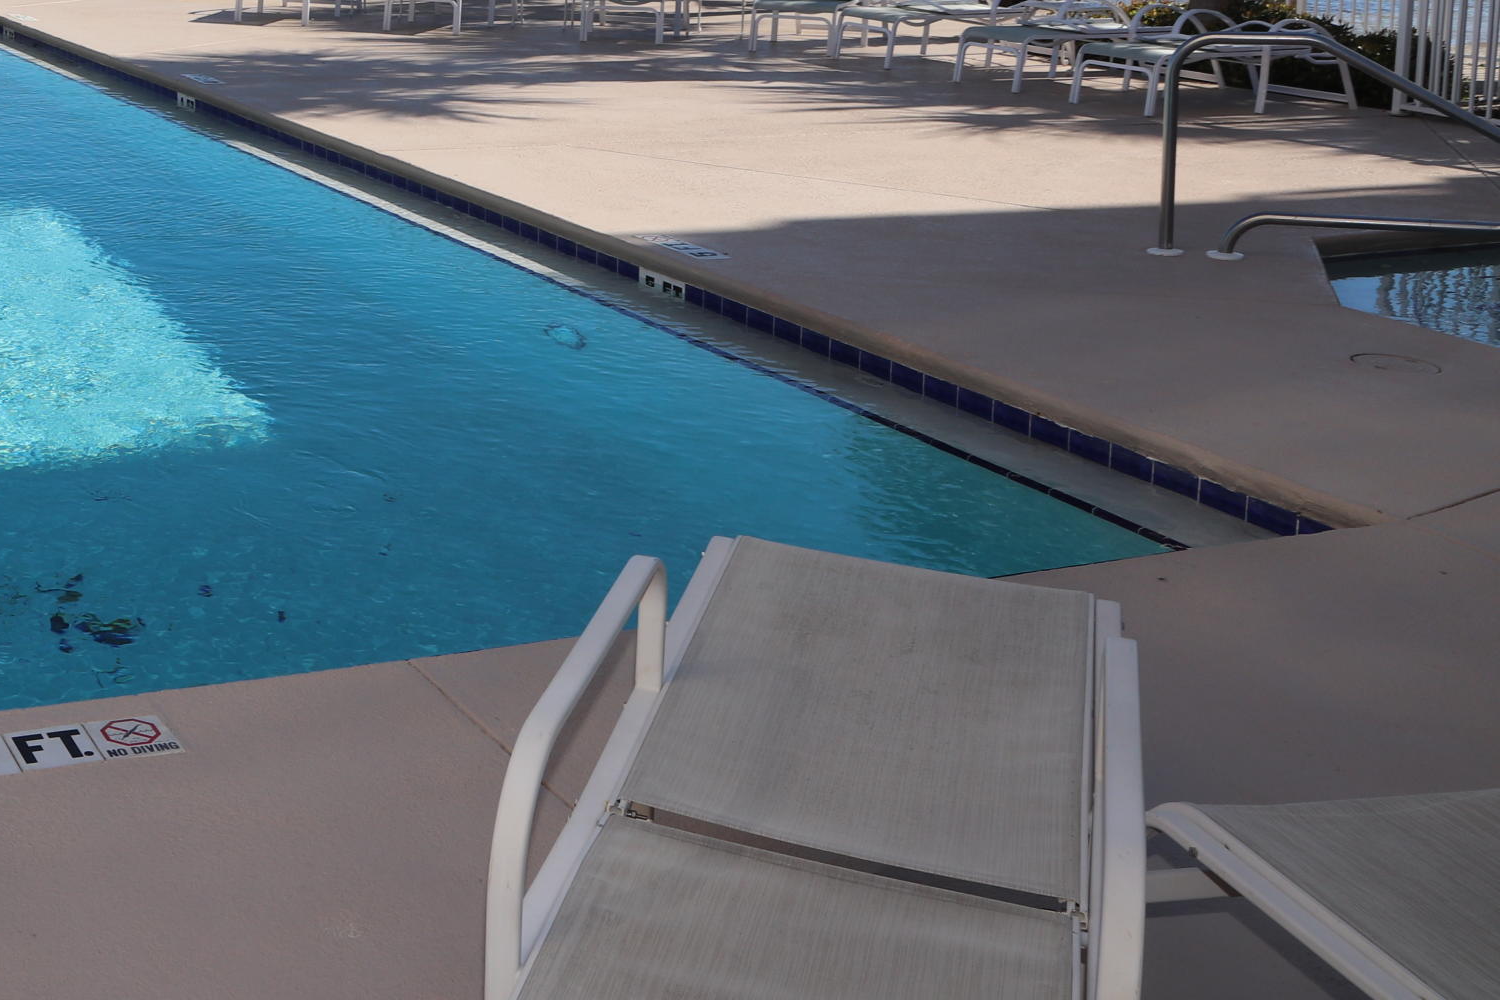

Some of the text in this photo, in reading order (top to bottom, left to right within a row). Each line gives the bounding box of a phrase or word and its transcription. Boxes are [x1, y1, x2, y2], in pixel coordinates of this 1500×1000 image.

[11, 729, 95, 765] FT.
[107, 740, 180, 758] NO DIVING
